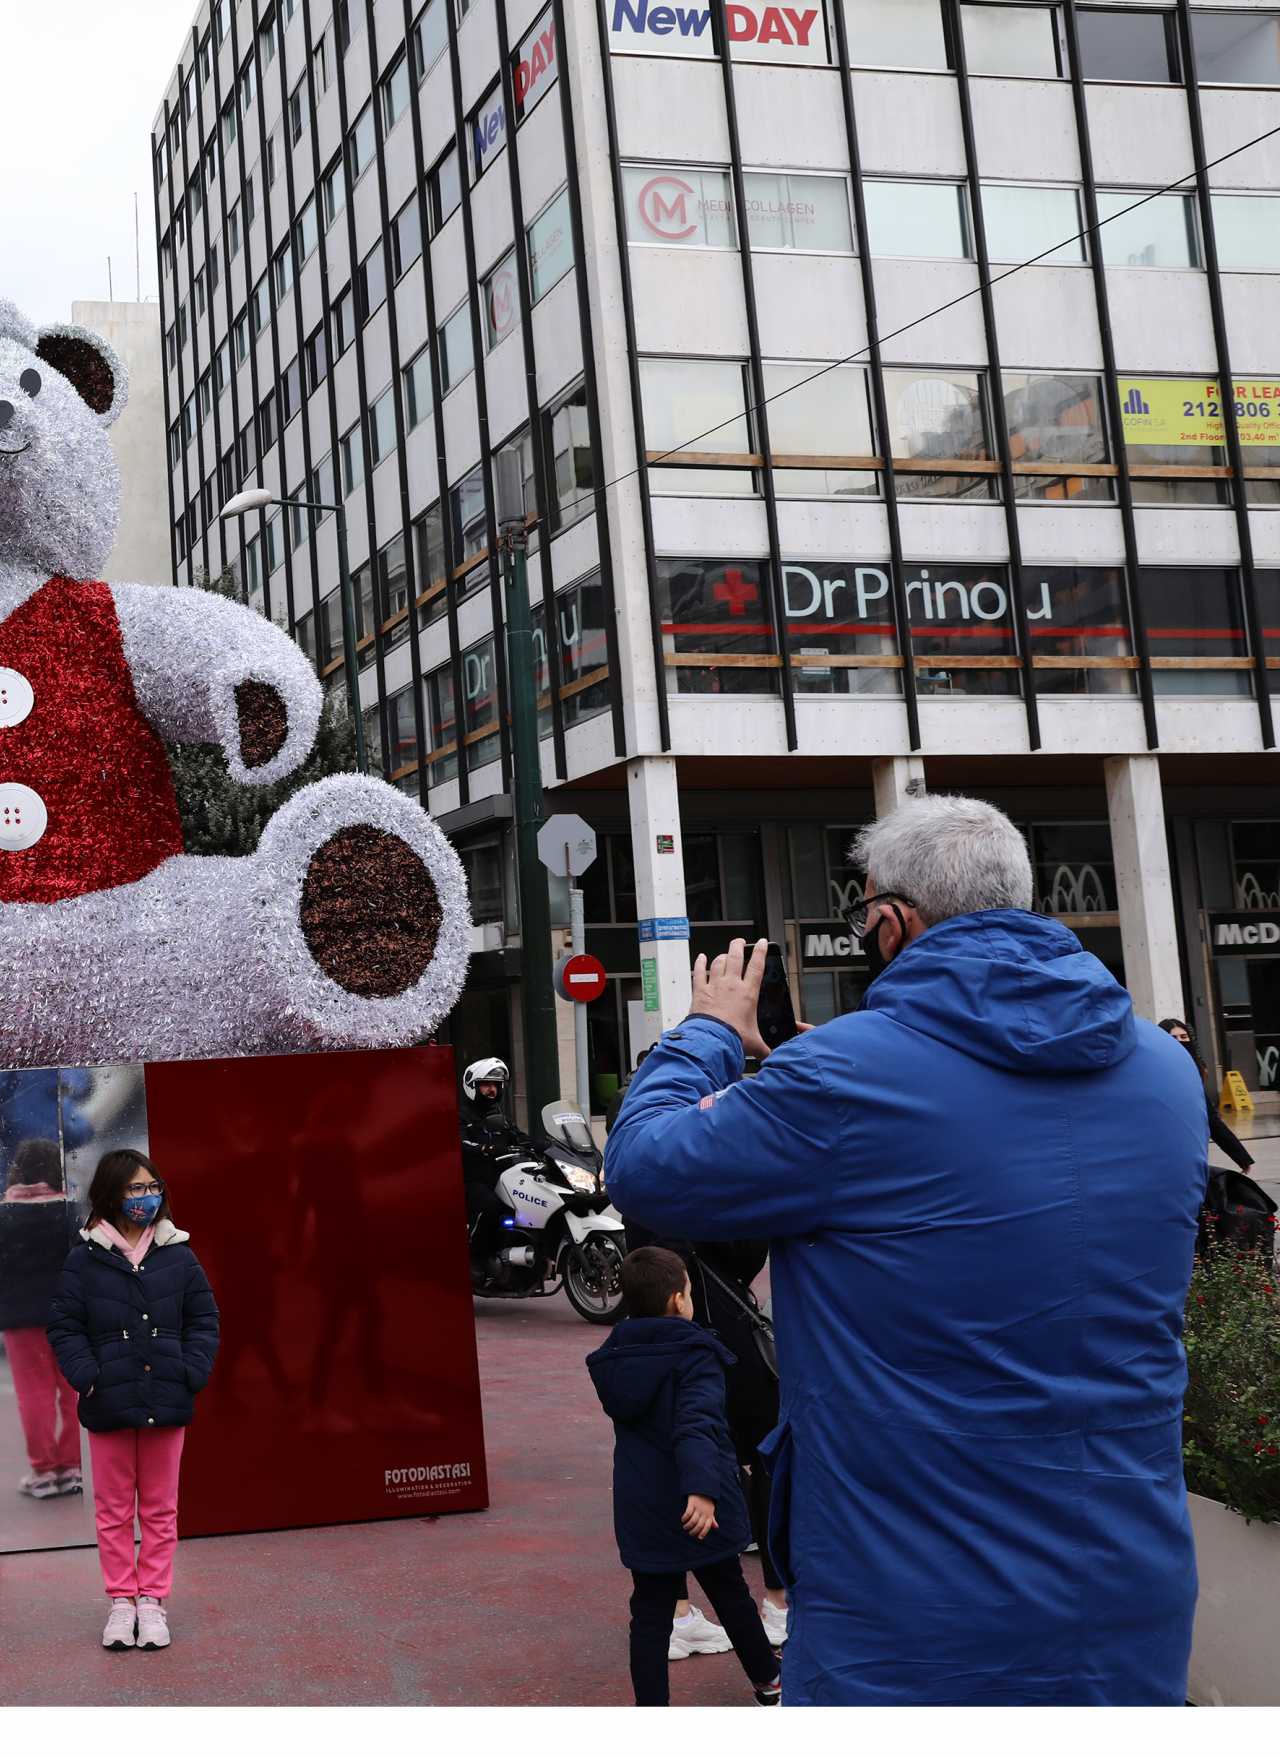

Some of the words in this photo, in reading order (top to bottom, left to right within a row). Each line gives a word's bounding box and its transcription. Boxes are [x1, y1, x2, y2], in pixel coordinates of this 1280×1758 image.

[612, 0, 712, 36] New
[725, 4, 818, 46] DAY
[514, 20, 558, 106] DAY
[781, 566, 846, 618] Dr
[464, 654, 490, 700] Dr
[512, 1189, 549, 1209] POLICE
[385, 1462, 471, 1485] FOTODIASTASI
